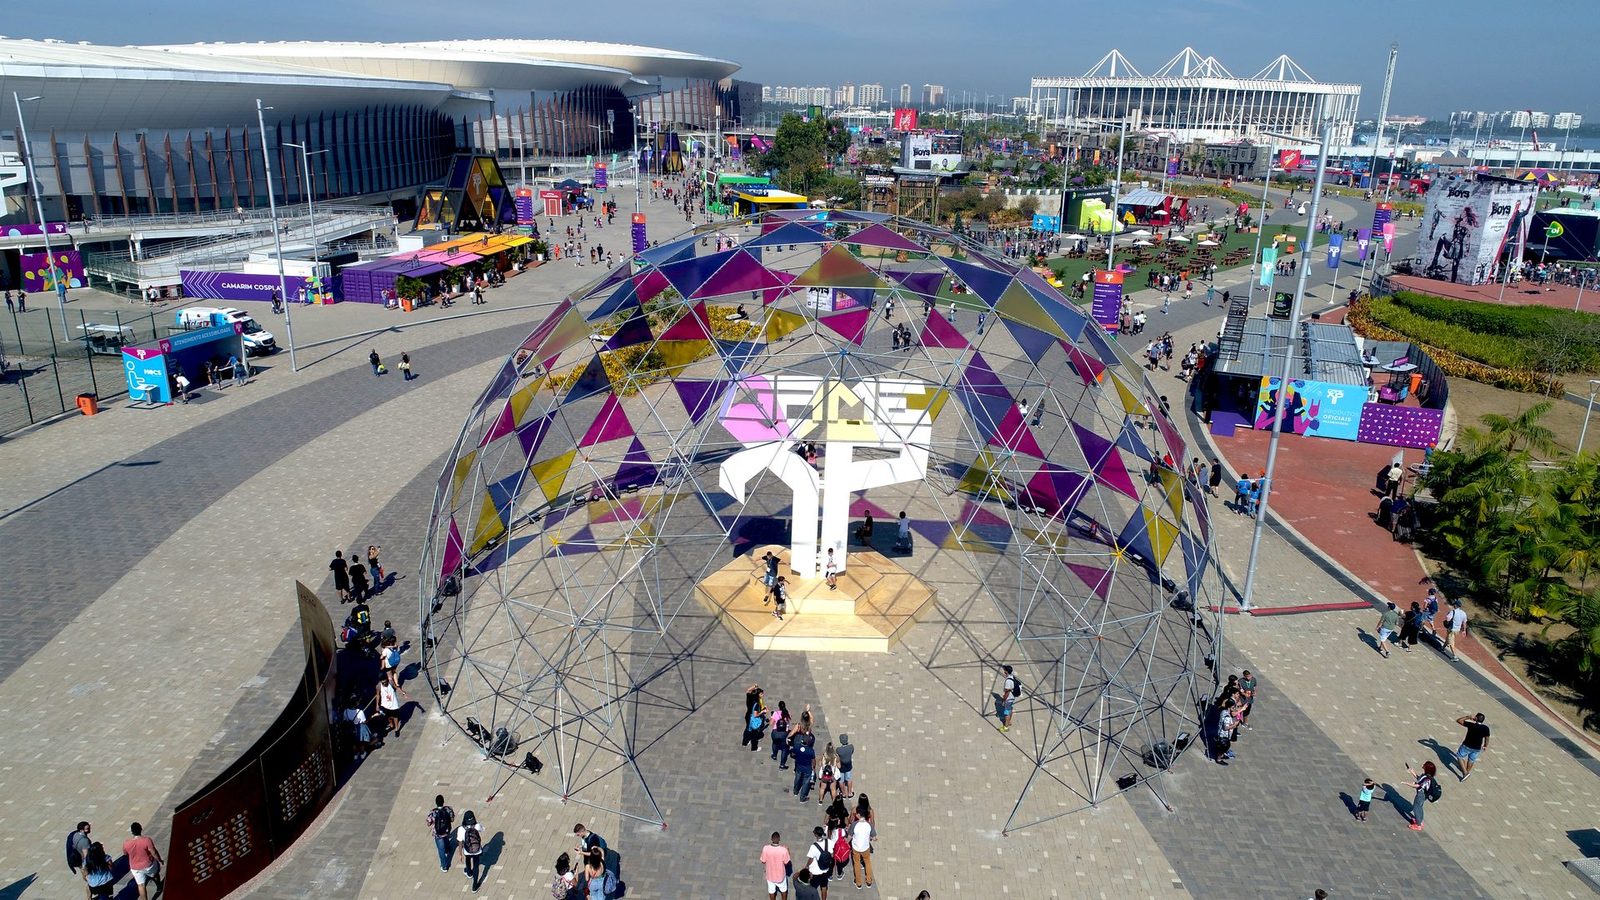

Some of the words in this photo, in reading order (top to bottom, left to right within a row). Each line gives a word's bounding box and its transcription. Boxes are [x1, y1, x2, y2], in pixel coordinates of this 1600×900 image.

[1447, 189, 1470, 199] BOYS
[1489, 204, 1512, 217] BOYS
[221, 282, 253, 290] CAMARIM
[1322, 414, 1352, 422] OFICIAIS
